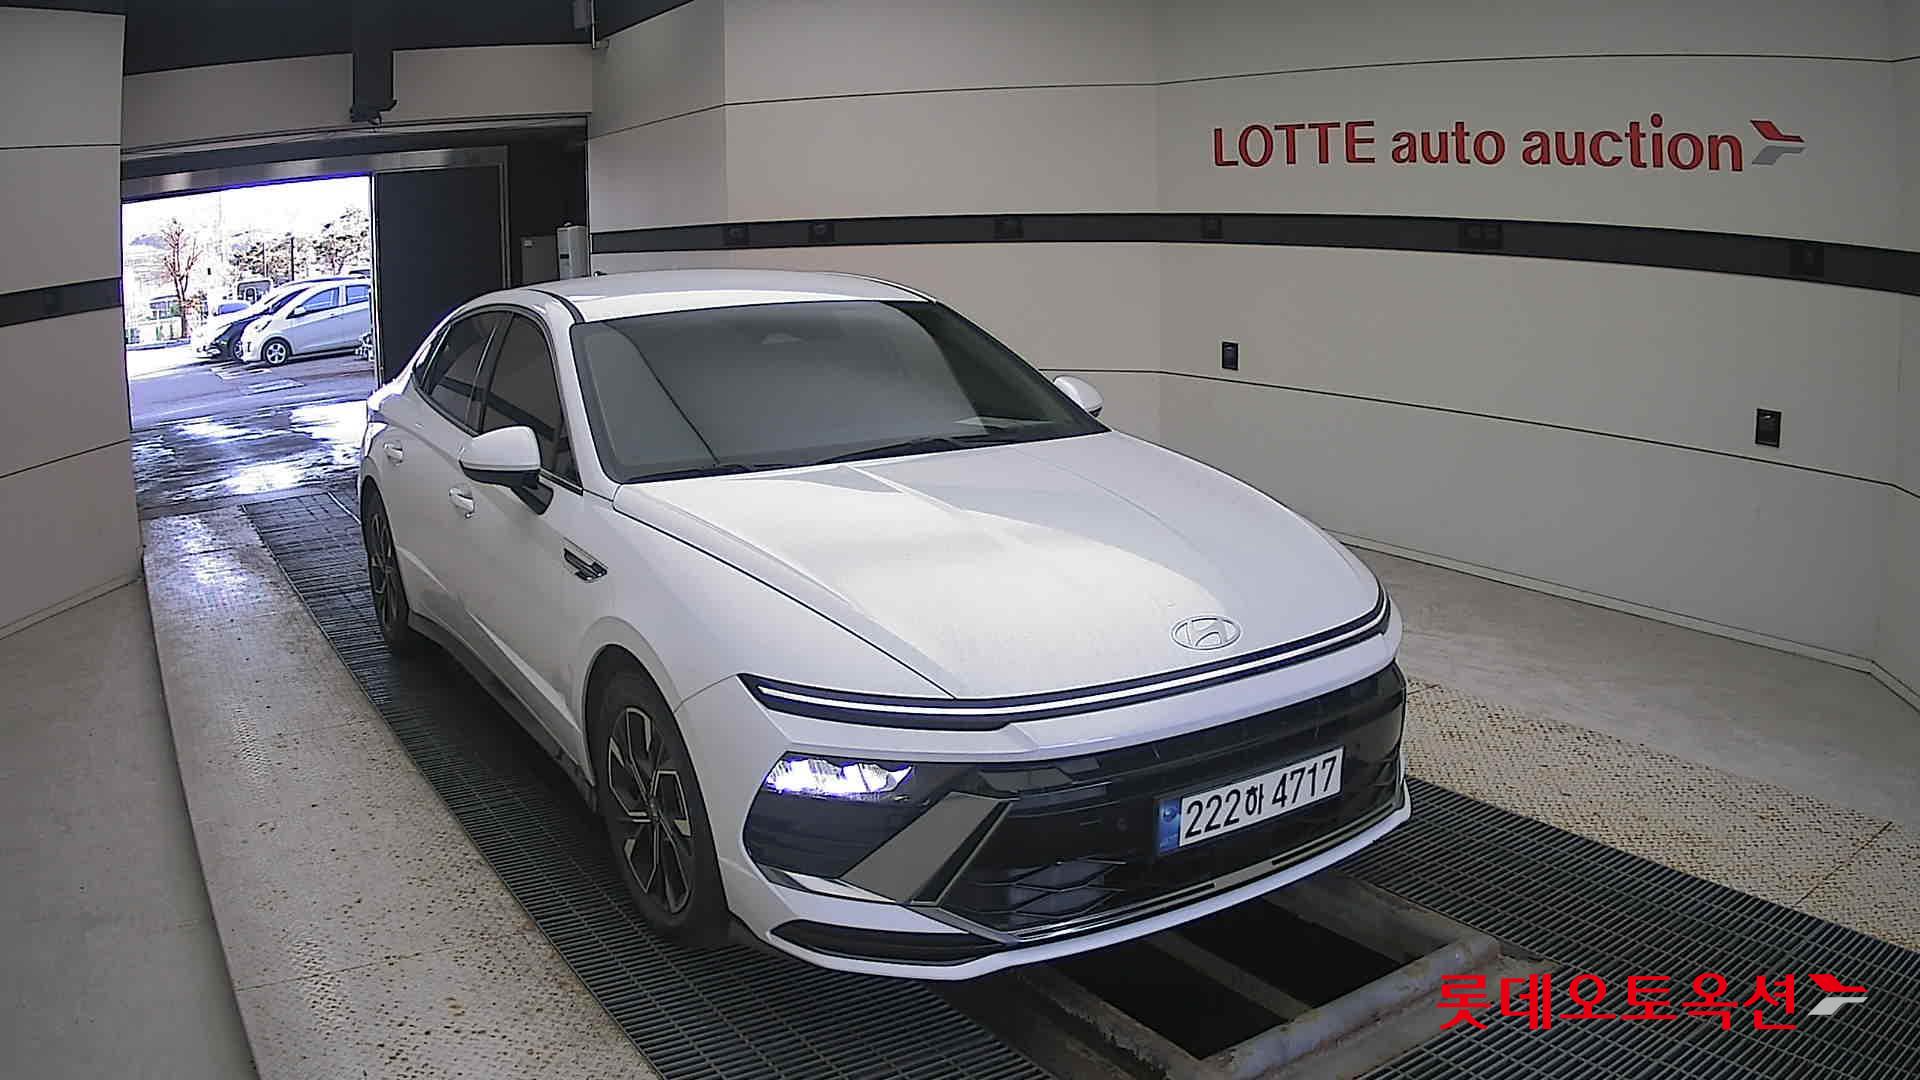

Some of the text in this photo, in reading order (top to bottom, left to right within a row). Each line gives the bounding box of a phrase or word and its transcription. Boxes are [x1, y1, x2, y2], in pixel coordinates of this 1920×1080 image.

[1213, 113, 1744, 172] LOTTE auto auction
[1184, 755, 1338, 839] 222하 4717
